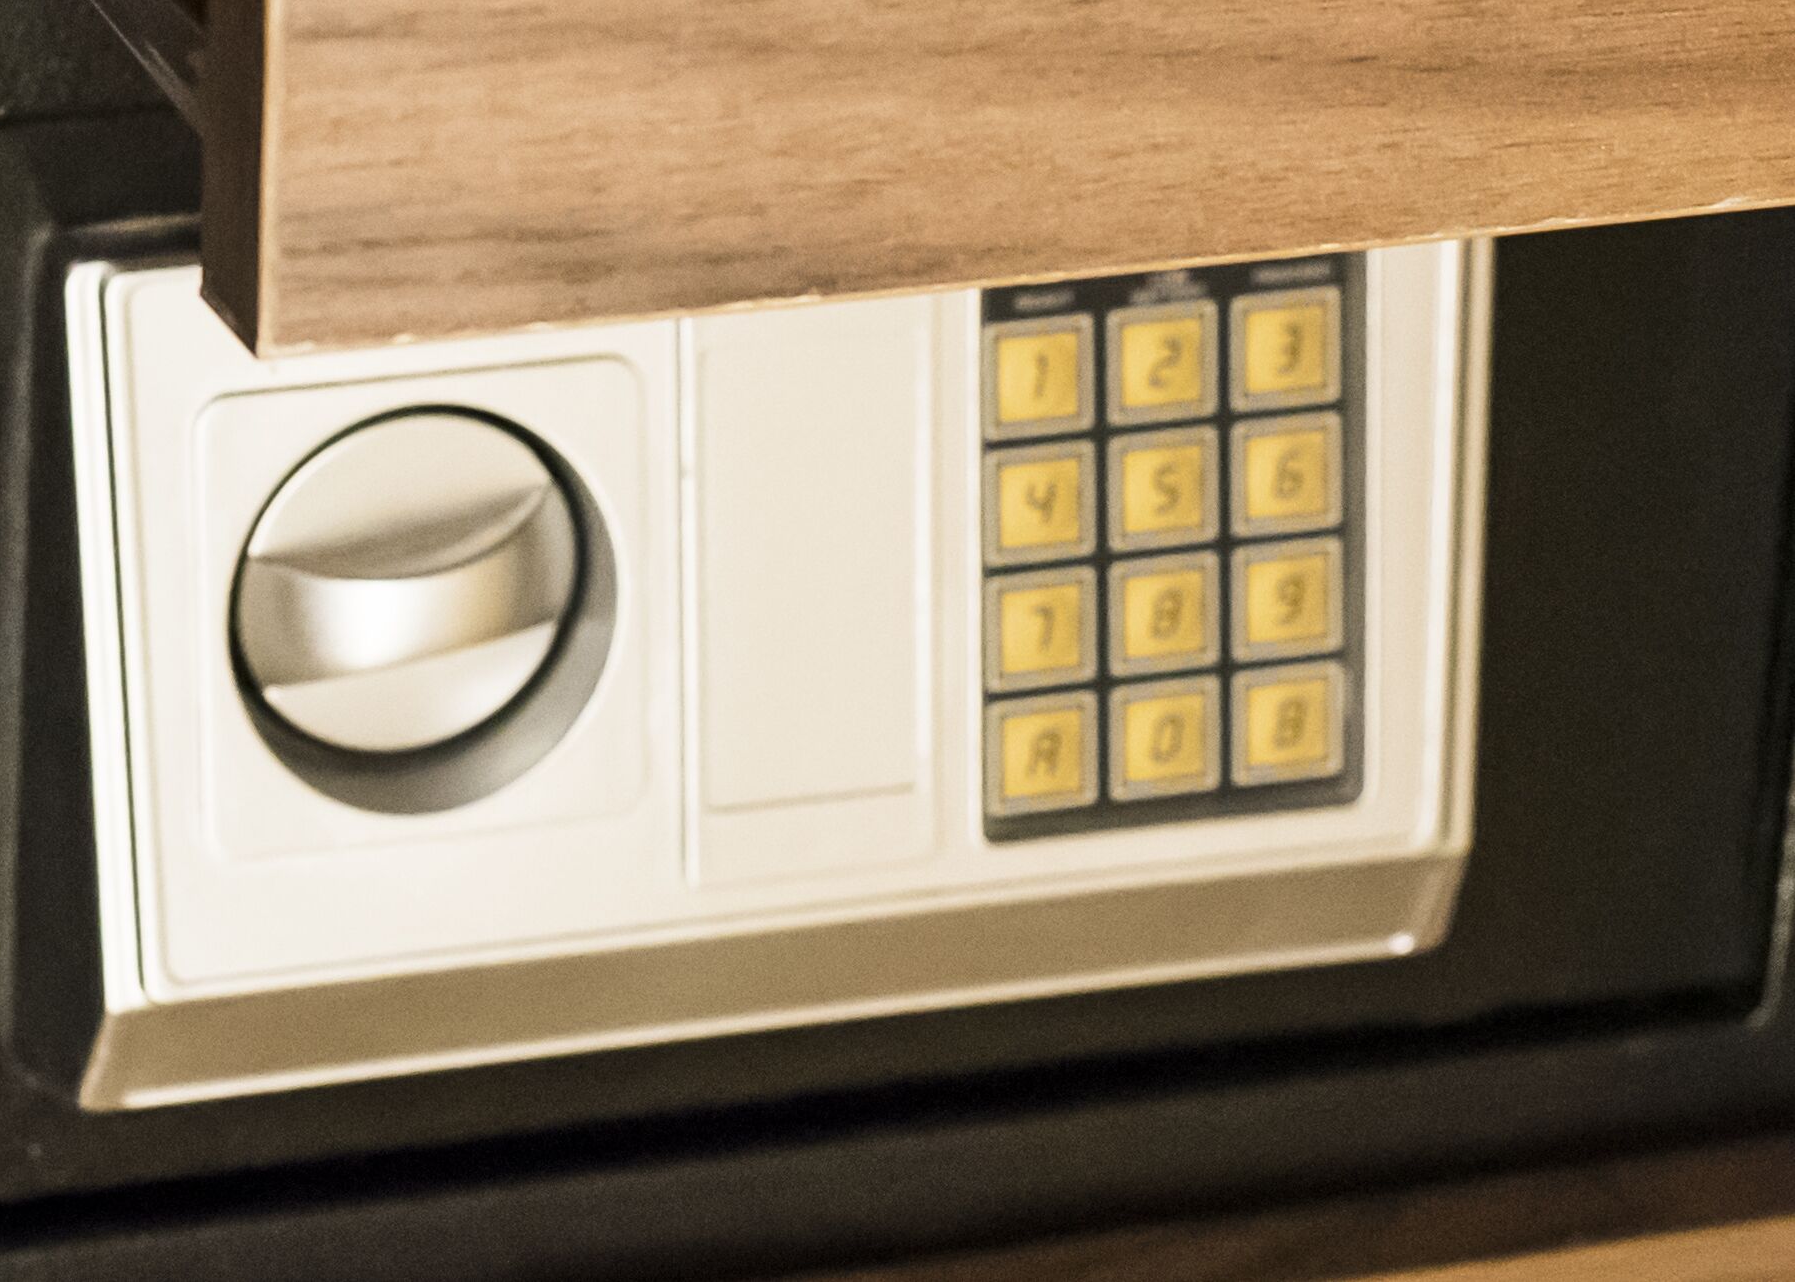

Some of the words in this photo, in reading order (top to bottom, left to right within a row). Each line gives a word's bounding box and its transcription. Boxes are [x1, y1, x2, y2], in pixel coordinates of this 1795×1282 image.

[1034, 351, 1050, 400] 1
[1146, 334, 1182, 390] 2
[1276, 321, 1303, 376] 3
[1025, 479, 1058, 525] 4
[1151, 461, 1182, 516] 5
[1271, 446, 1304, 501] 6
[1032, 601, 1056, 653] 7
[1148, 586, 1183, 641] 8
[1274, 573, 1306, 626] 9
[1026, 728, 1063, 779] A
[1149, 713, 1184, 764] 0
